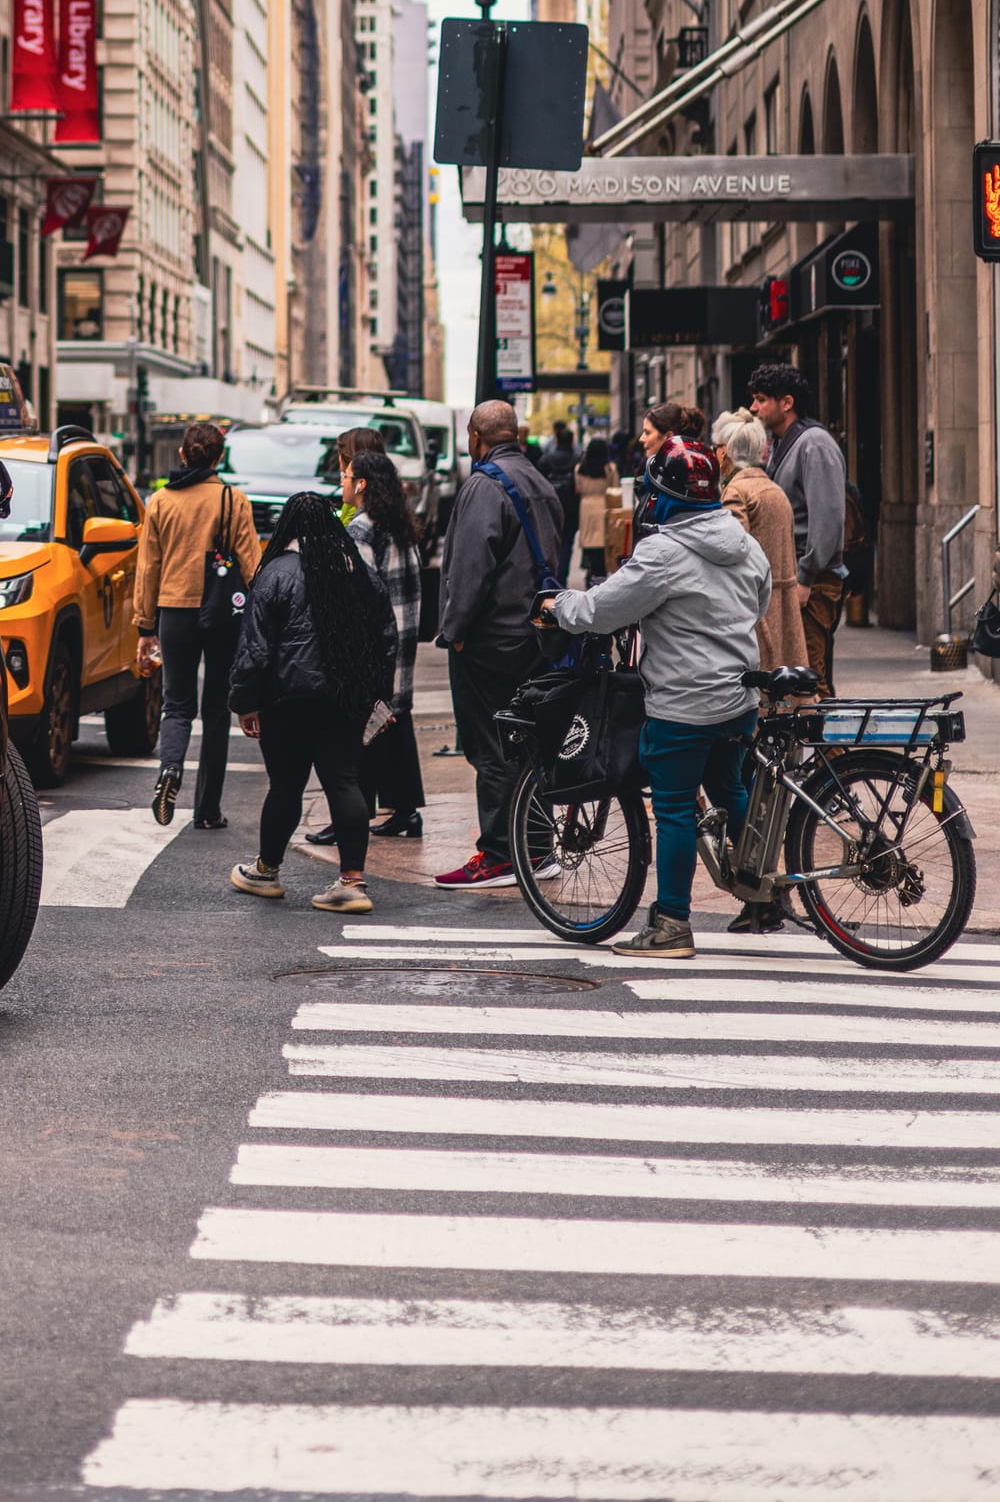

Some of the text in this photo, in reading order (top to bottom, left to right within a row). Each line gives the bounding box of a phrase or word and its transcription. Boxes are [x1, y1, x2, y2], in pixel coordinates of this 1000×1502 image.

[62, 1, 91, 91] Library
[567, 177, 681, 195] MADISON
[692, 174, 791, 194] AVENUE
